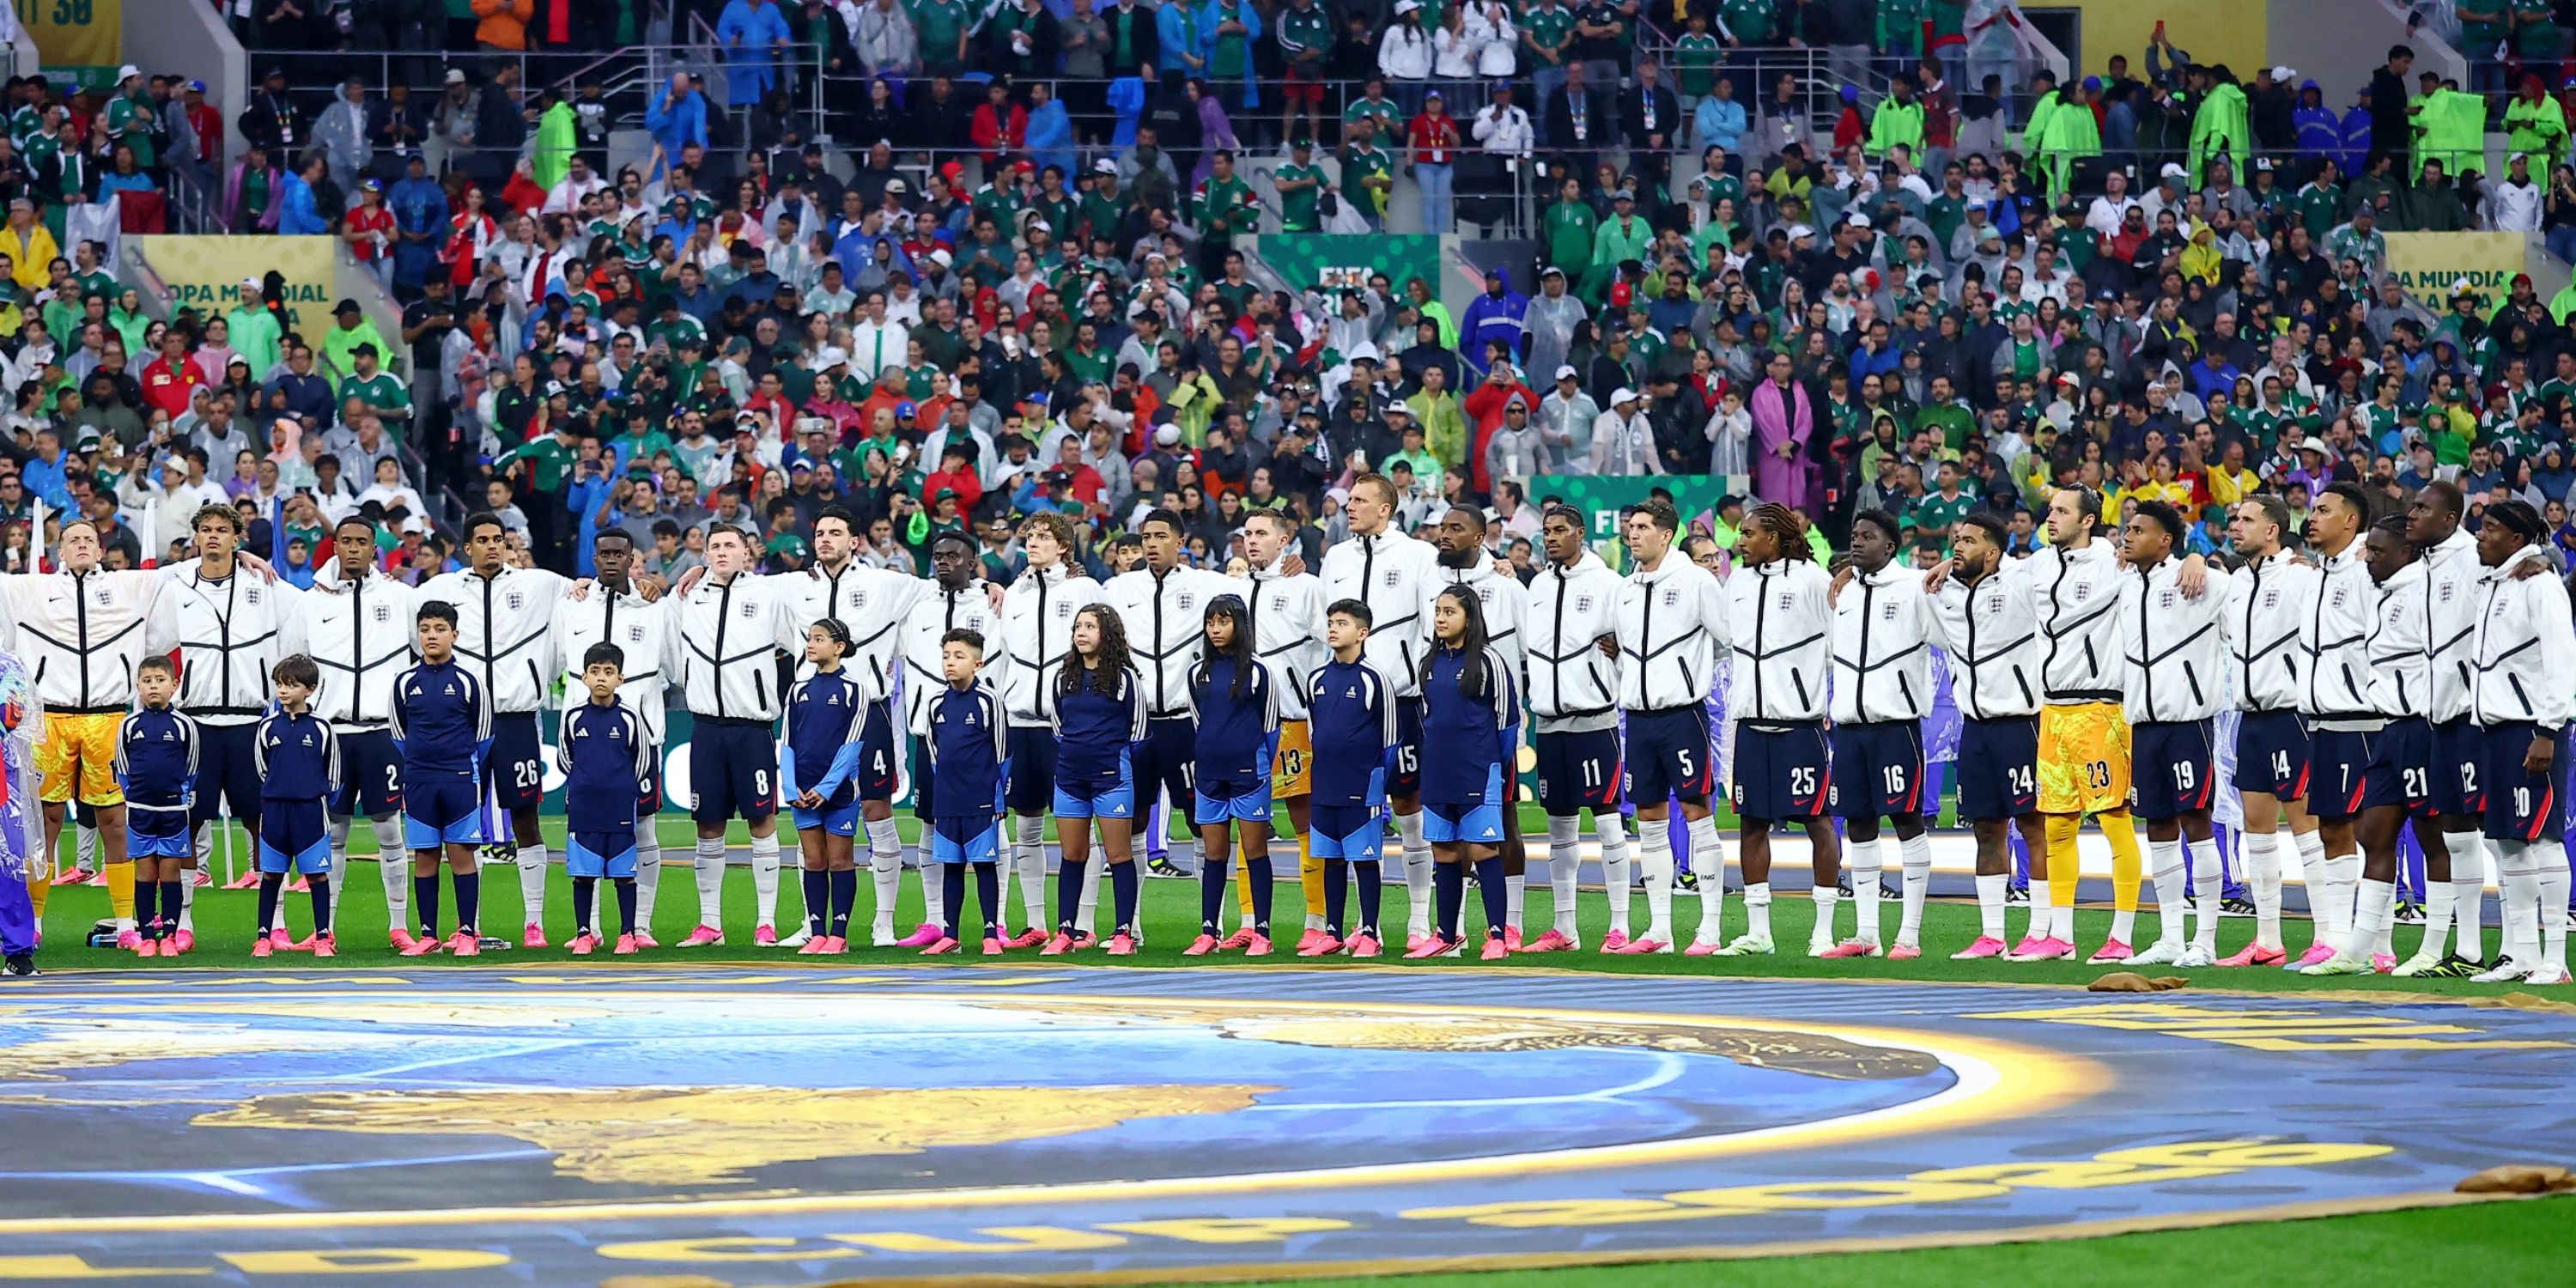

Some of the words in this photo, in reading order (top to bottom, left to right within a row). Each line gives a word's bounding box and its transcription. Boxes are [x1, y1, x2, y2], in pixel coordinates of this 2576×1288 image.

[168, 284, 214, 302] OPA
[514, 758, 539, 788] 26
[873, 749, 887, 775] 4
[1279, 747, 1303, 776] 13
[1397, 744, 1419, 774] 15
[1582, 757, 1601, 787] 11
[1677, 748, 1694, 778] 5
[2086, 759, 2111, 789] 23
[2271, 749, 2292, 781] 14
[386, 763, 399, 791] 2
[755, 769, 769, 796] 8
[1791, 766, 1815, 796] 25
[1883, 763, 1905, 794] 16
[2008, 764, 2034, 796] 24
[2172, 760, 2195, 791] 19
[2340, 762, 2349, 793] 7
[2403, 766, 2428, 798] 21
[2460, 761, 2478, 793] 12
[596, 1216, 1355, 1262] CUP
[1395, 1140, 2397, 1228] 2026
